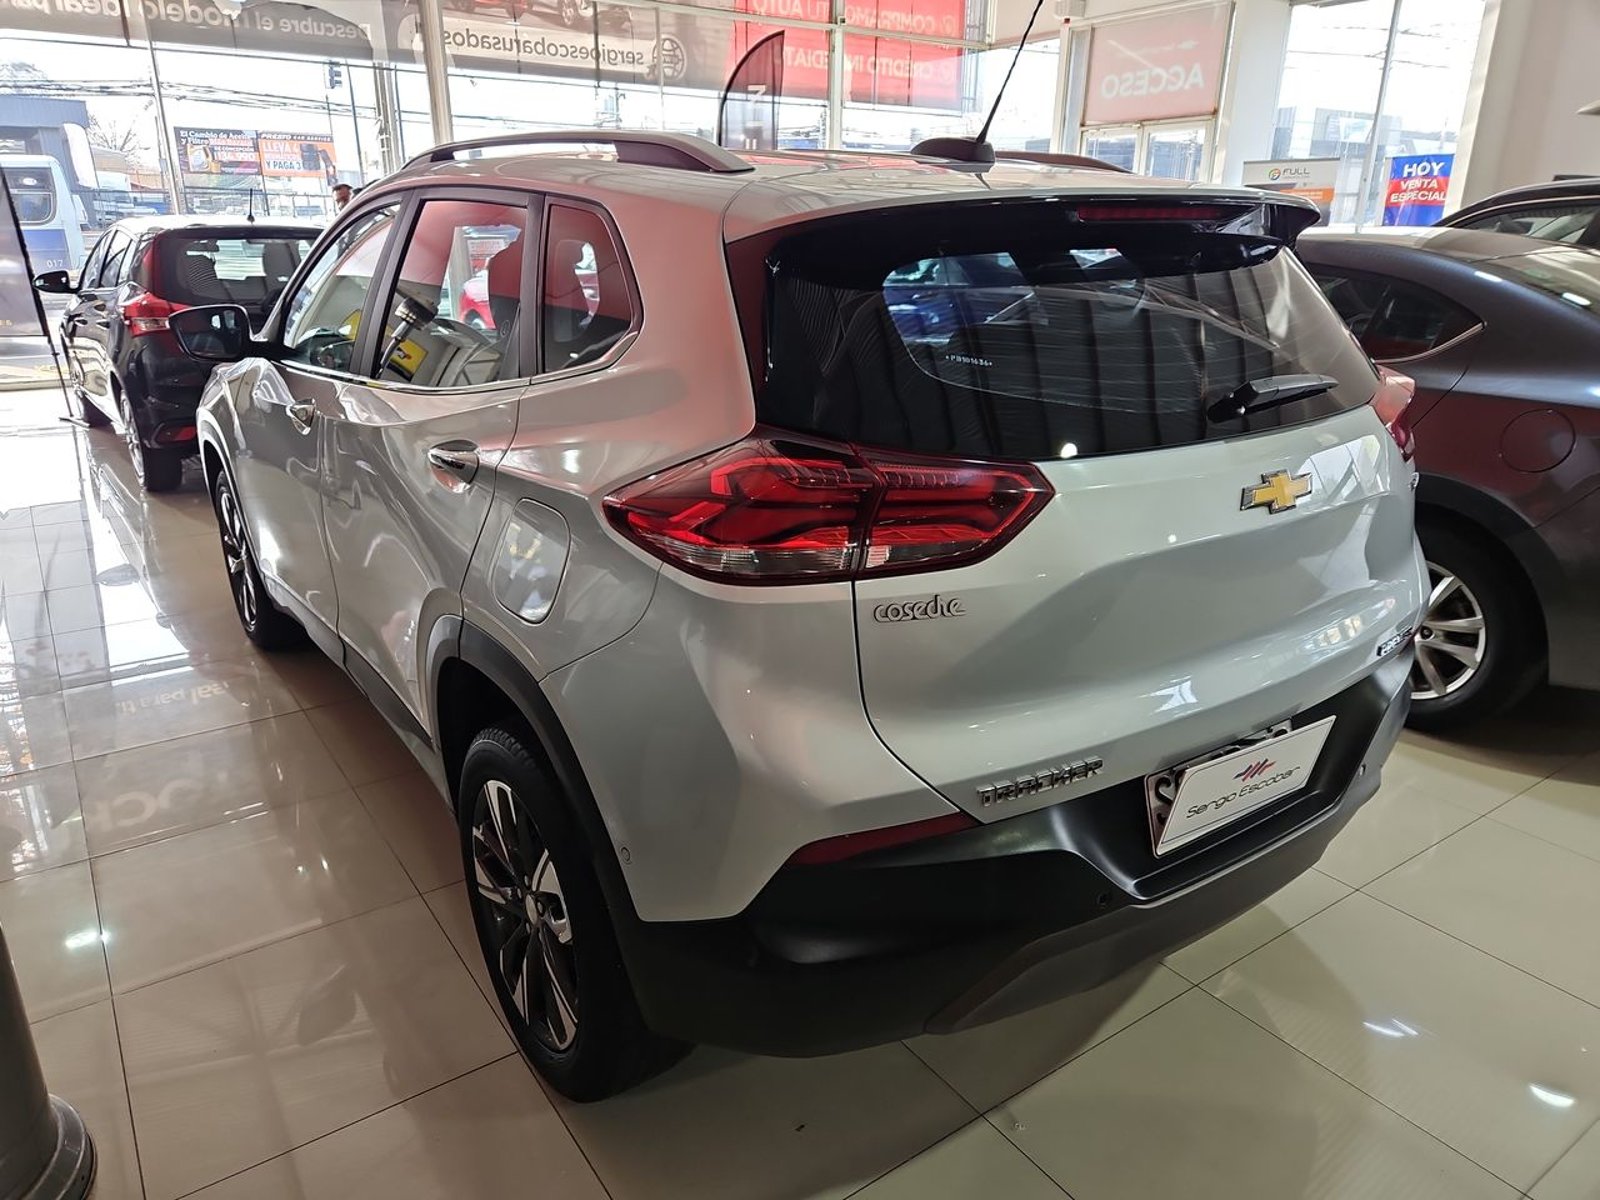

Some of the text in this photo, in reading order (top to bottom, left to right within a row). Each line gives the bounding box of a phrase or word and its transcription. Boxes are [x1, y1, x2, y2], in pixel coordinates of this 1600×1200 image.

[273, 160, 295, 170] PAGA
[1403, 161, 1445, 178] HOY
[1282, 167, 1311, 176] FULL
[1400, 178, 1438, 190] VENTA
[1390, 190, 1447, 202] ESPECIAL
[46, 259, 64, 268] 017
[977, 755, 1105, 807] TRACKER
